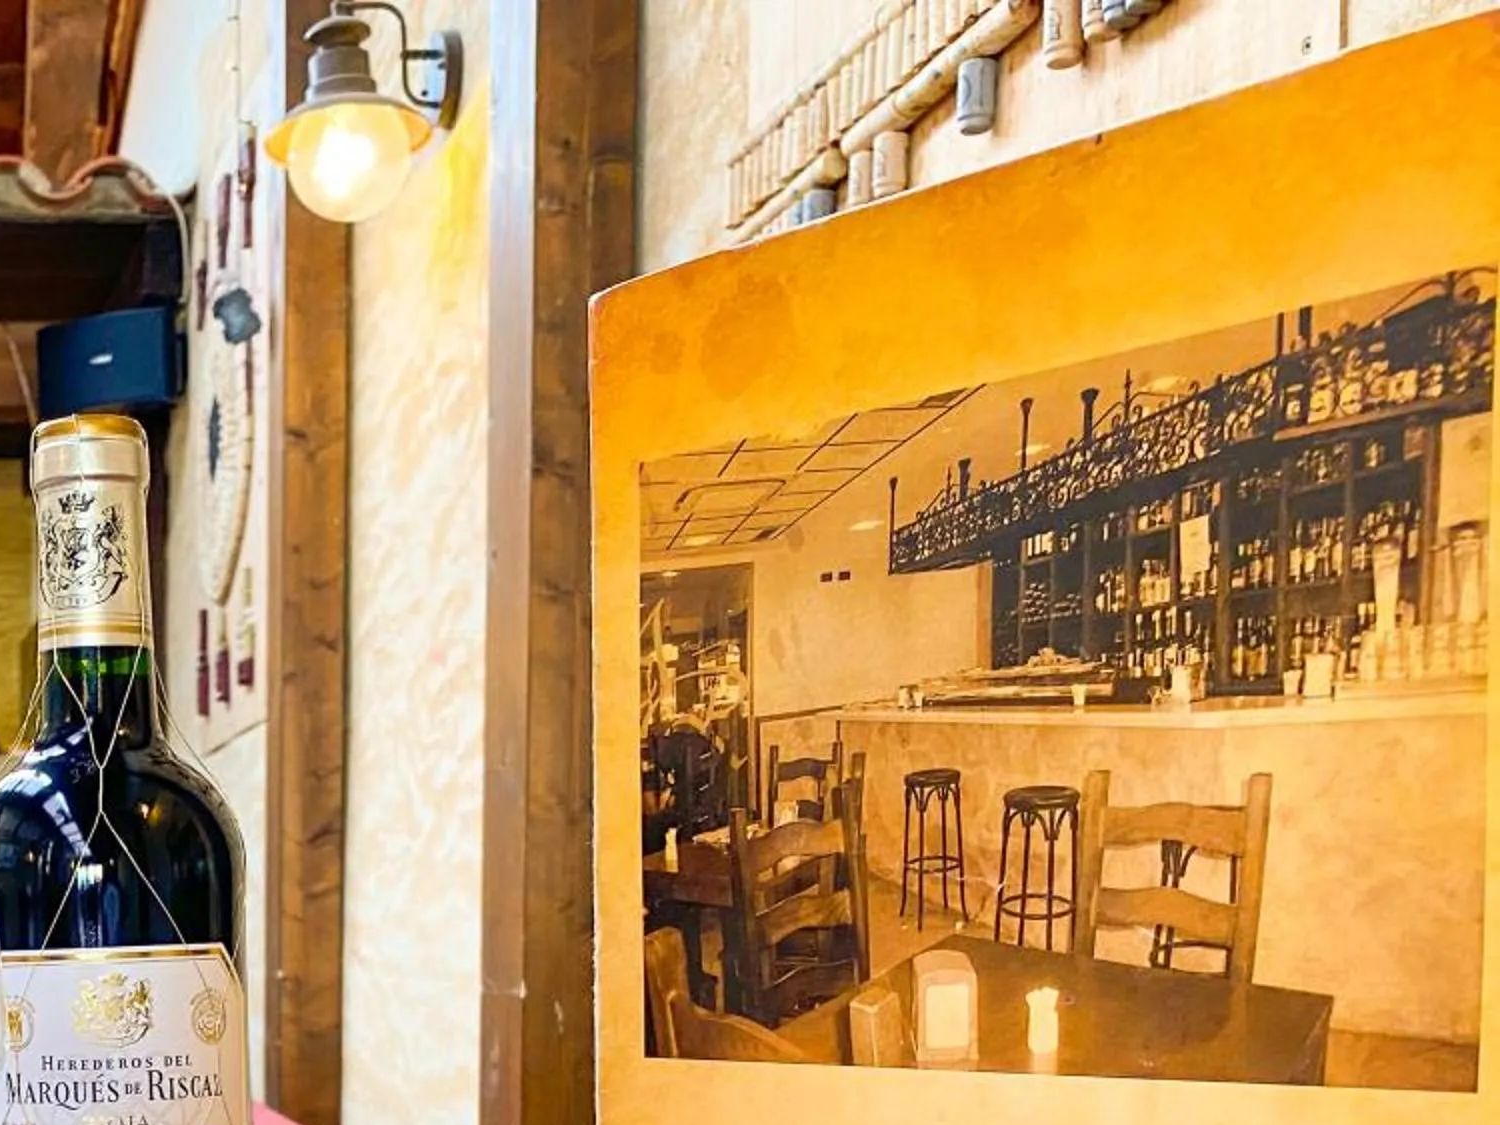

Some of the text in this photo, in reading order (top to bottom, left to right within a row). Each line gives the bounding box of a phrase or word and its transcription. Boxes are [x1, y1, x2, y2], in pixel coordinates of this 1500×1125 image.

[41, 1054, 193, 1071] HEREDEROS DEL
[6, 1072, 119, 1110] MARQUÉS
[125, 1083, 143, 1095] DE
